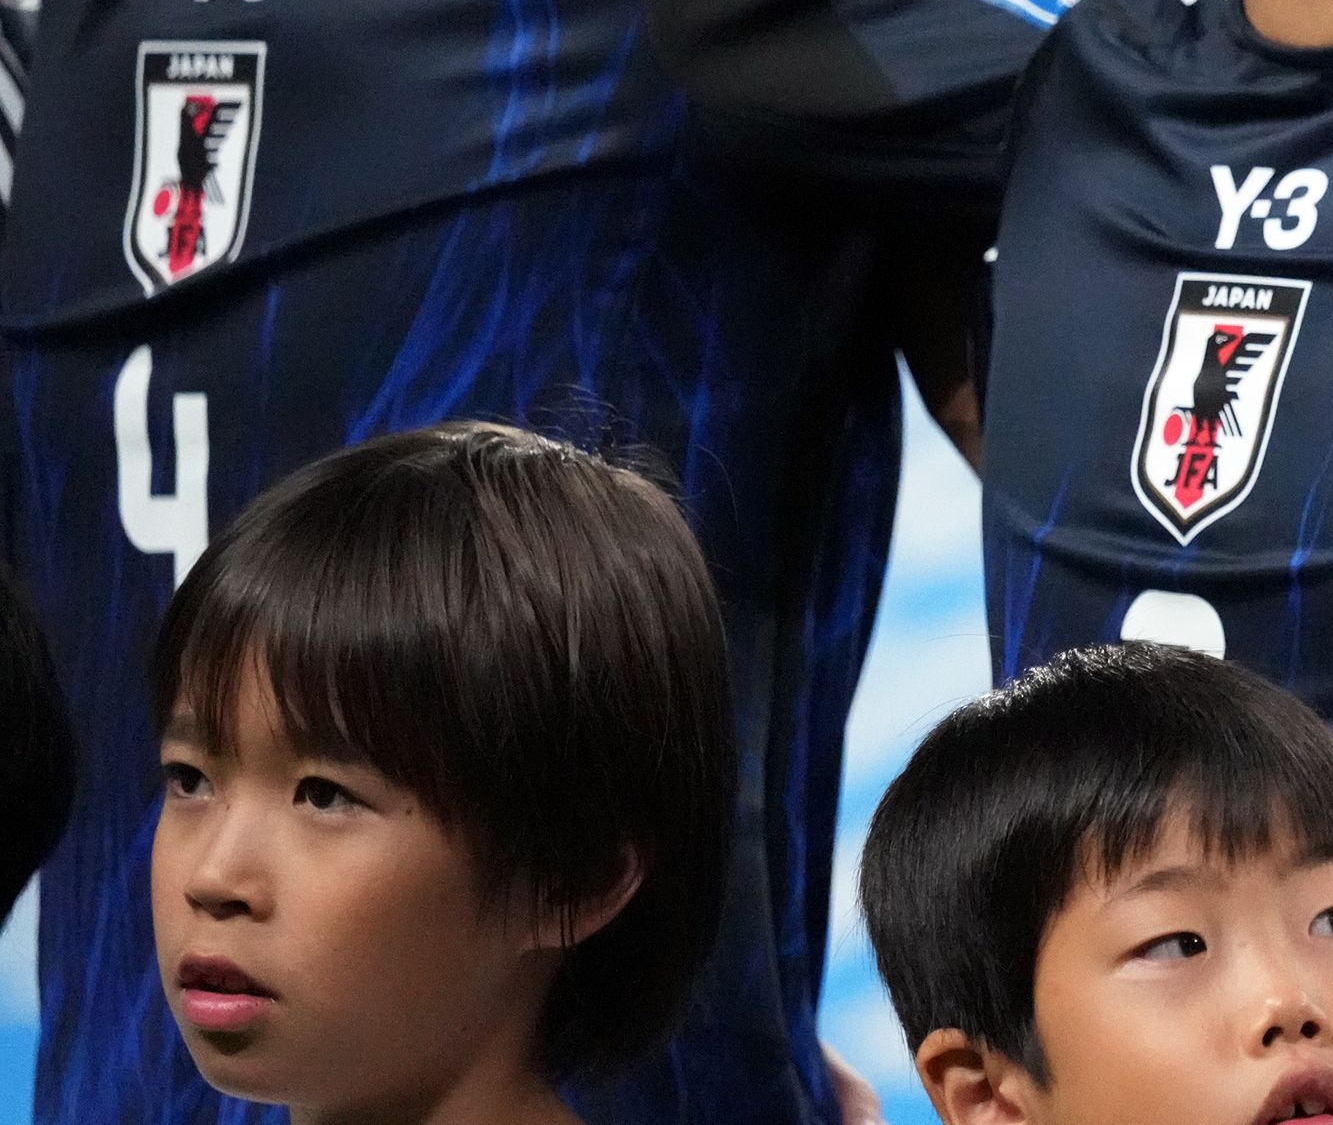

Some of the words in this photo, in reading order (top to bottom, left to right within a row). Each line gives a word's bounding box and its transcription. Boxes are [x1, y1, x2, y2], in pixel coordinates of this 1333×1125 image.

[167, 54, 234, 79] JAPAN
[1210, 165, 1330, 251] Y-3
[1202, 285, 1273, 311] JAPAN
[115, 345, 209, 589] 4
[1165, 453, 1218, 490] JFA
